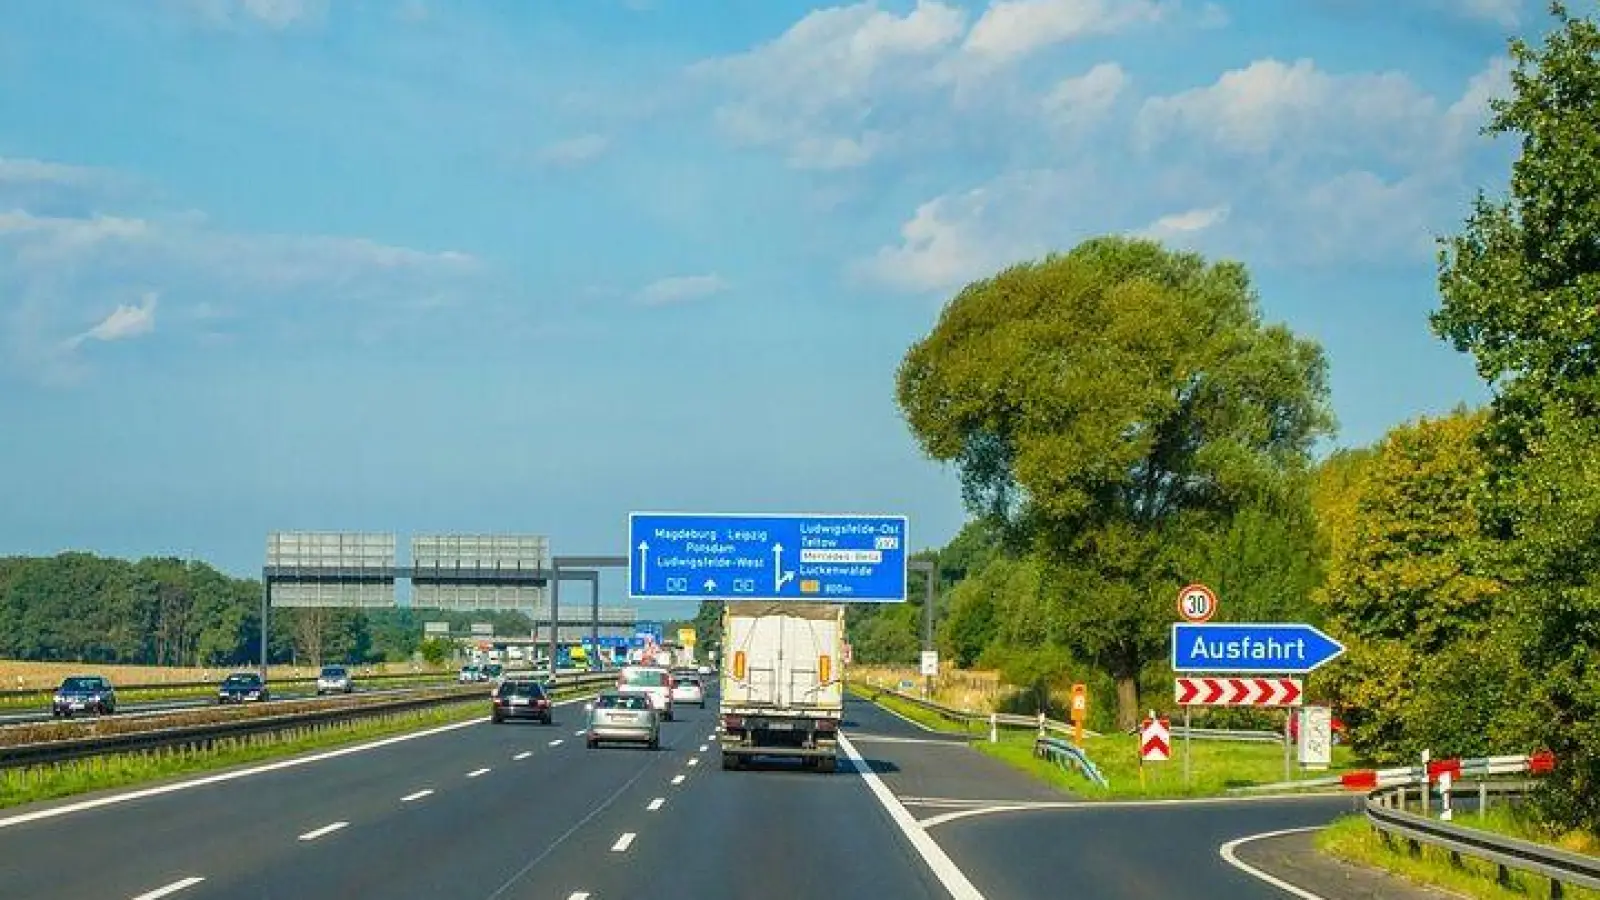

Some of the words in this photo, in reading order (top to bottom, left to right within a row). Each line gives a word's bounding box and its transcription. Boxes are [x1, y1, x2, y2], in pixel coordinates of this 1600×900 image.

[655, 528, 717, 541] Magdeburg
[728, 528, 768, 542] Leipzig
[686, 542, 735, 553] Potsdam
[657, 556, 765, 569] Ludwigsfelde-West
[800, 564, 872, 576] Luckenwalde
[1188, 595, 1206, 614] 30
[1190, 636, 1305, 659] Ausfahrt
